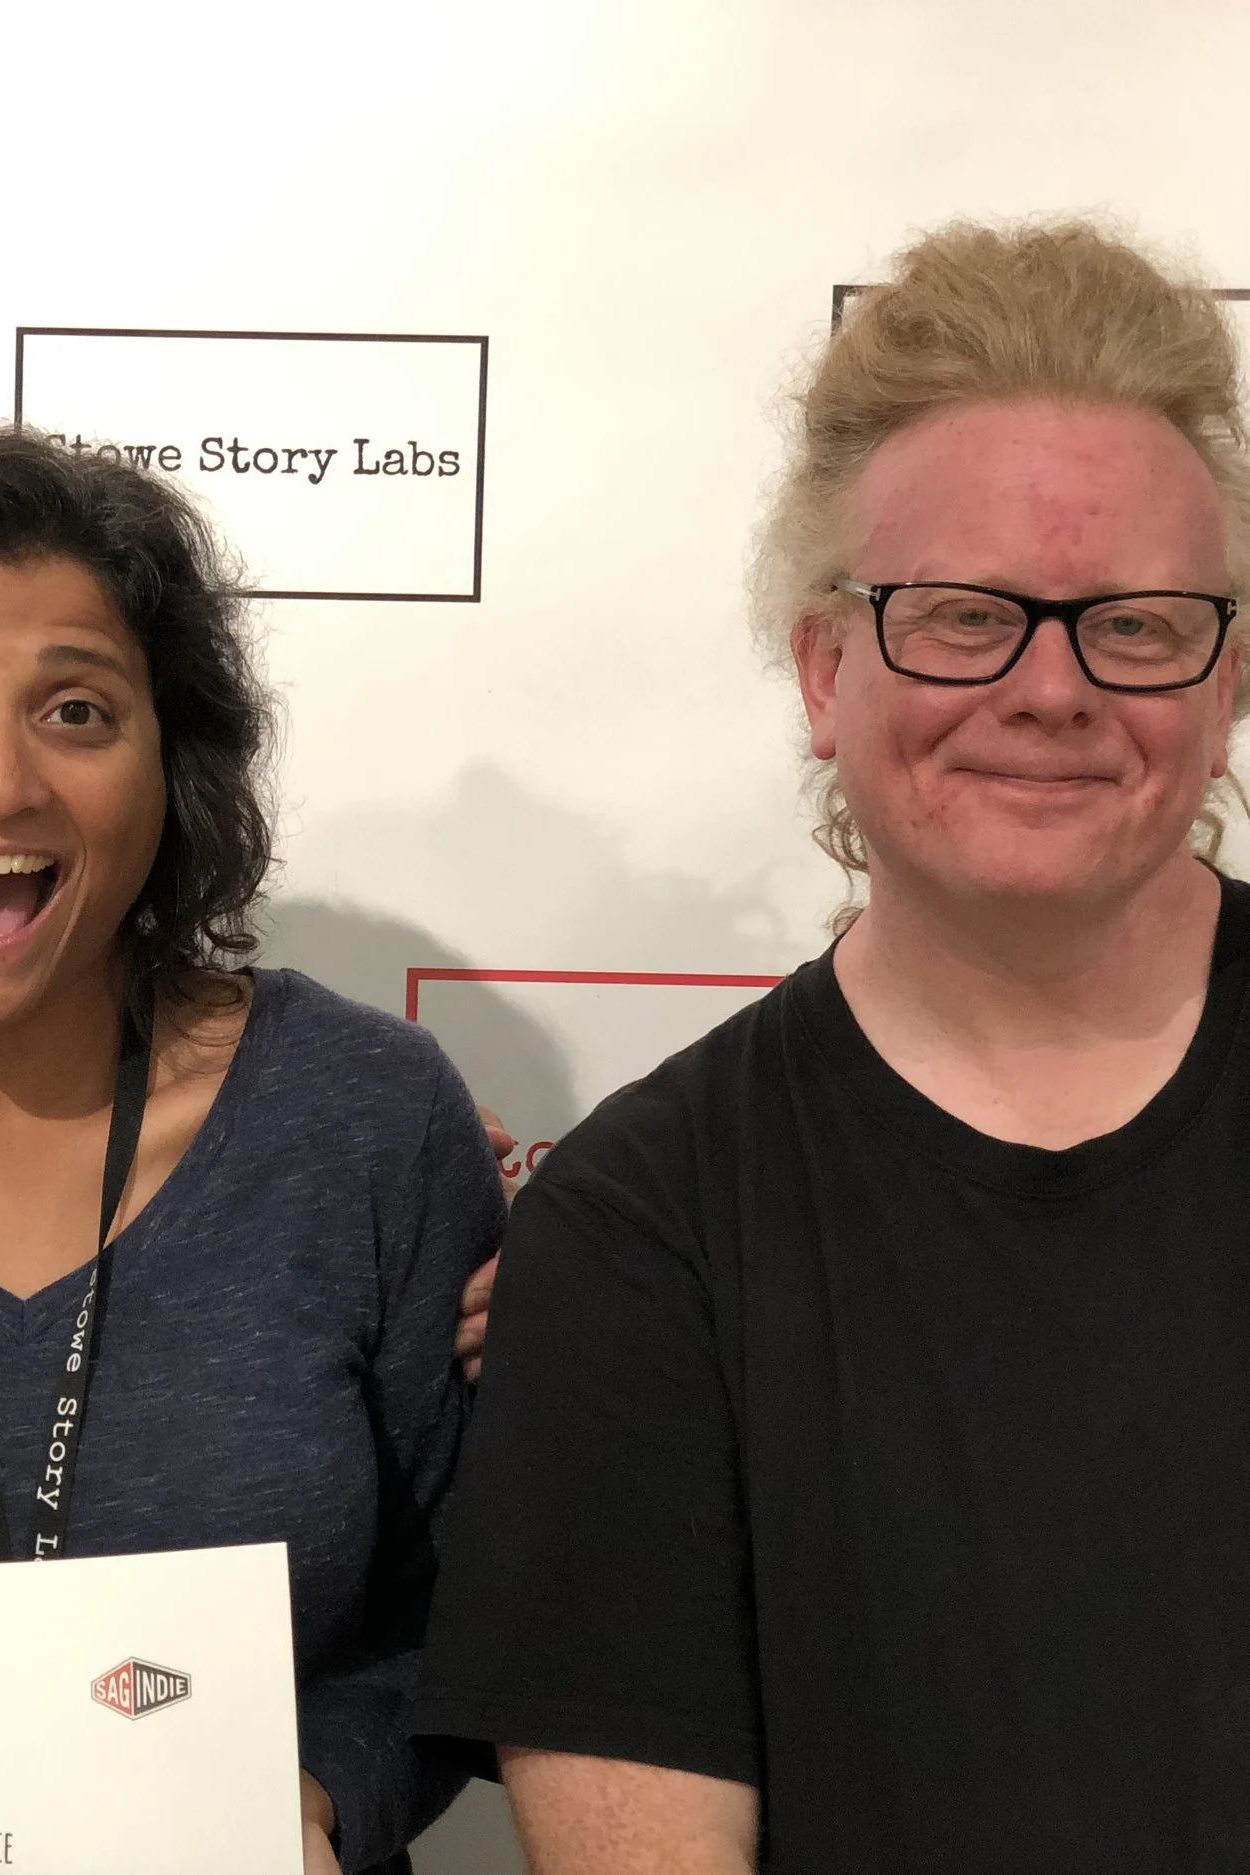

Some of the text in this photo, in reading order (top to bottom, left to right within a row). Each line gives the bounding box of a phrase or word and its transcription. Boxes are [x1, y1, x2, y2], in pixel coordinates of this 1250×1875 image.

[199, 436, 339, 486] Story
[352, 438, 462, 478] Labs
[36, 1397, 78, 1511] Story
